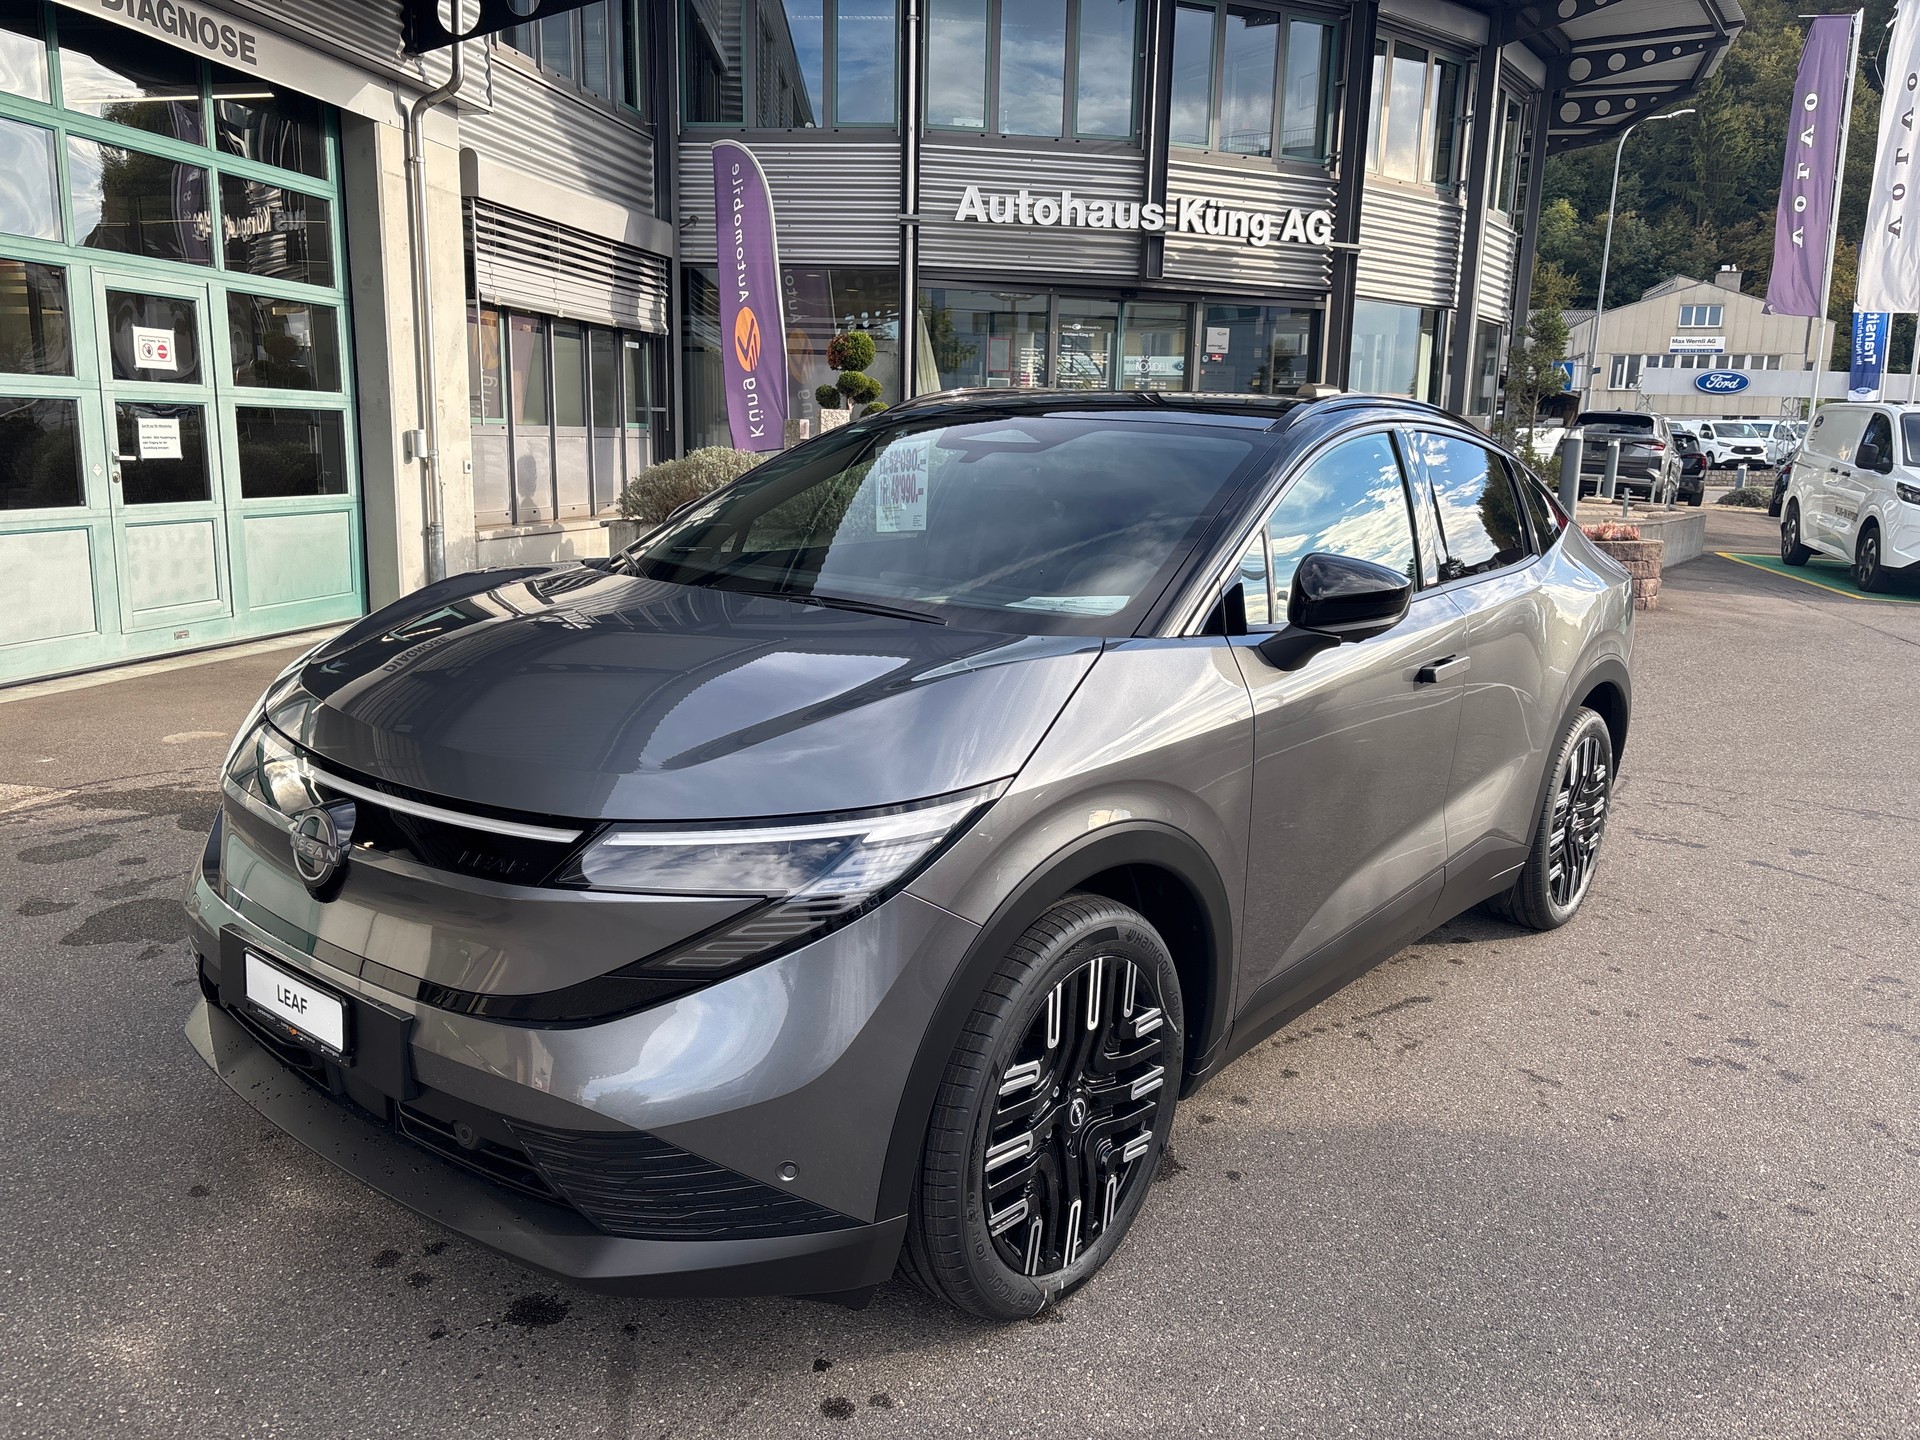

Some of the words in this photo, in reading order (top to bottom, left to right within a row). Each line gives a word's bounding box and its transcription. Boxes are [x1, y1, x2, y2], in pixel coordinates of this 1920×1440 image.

[101, 0, 257, 66] IAGNOSE
[954, 185, 1164, 231] Autohaus
[1177, 198, 1271, 247] Küng
[1279, 208, 1332, 245] AG
[1705, 374, 1741, 389] Ford
[290, 831, 338, 863] NISSAN
[276, 983, 308, 1015] LEAF
